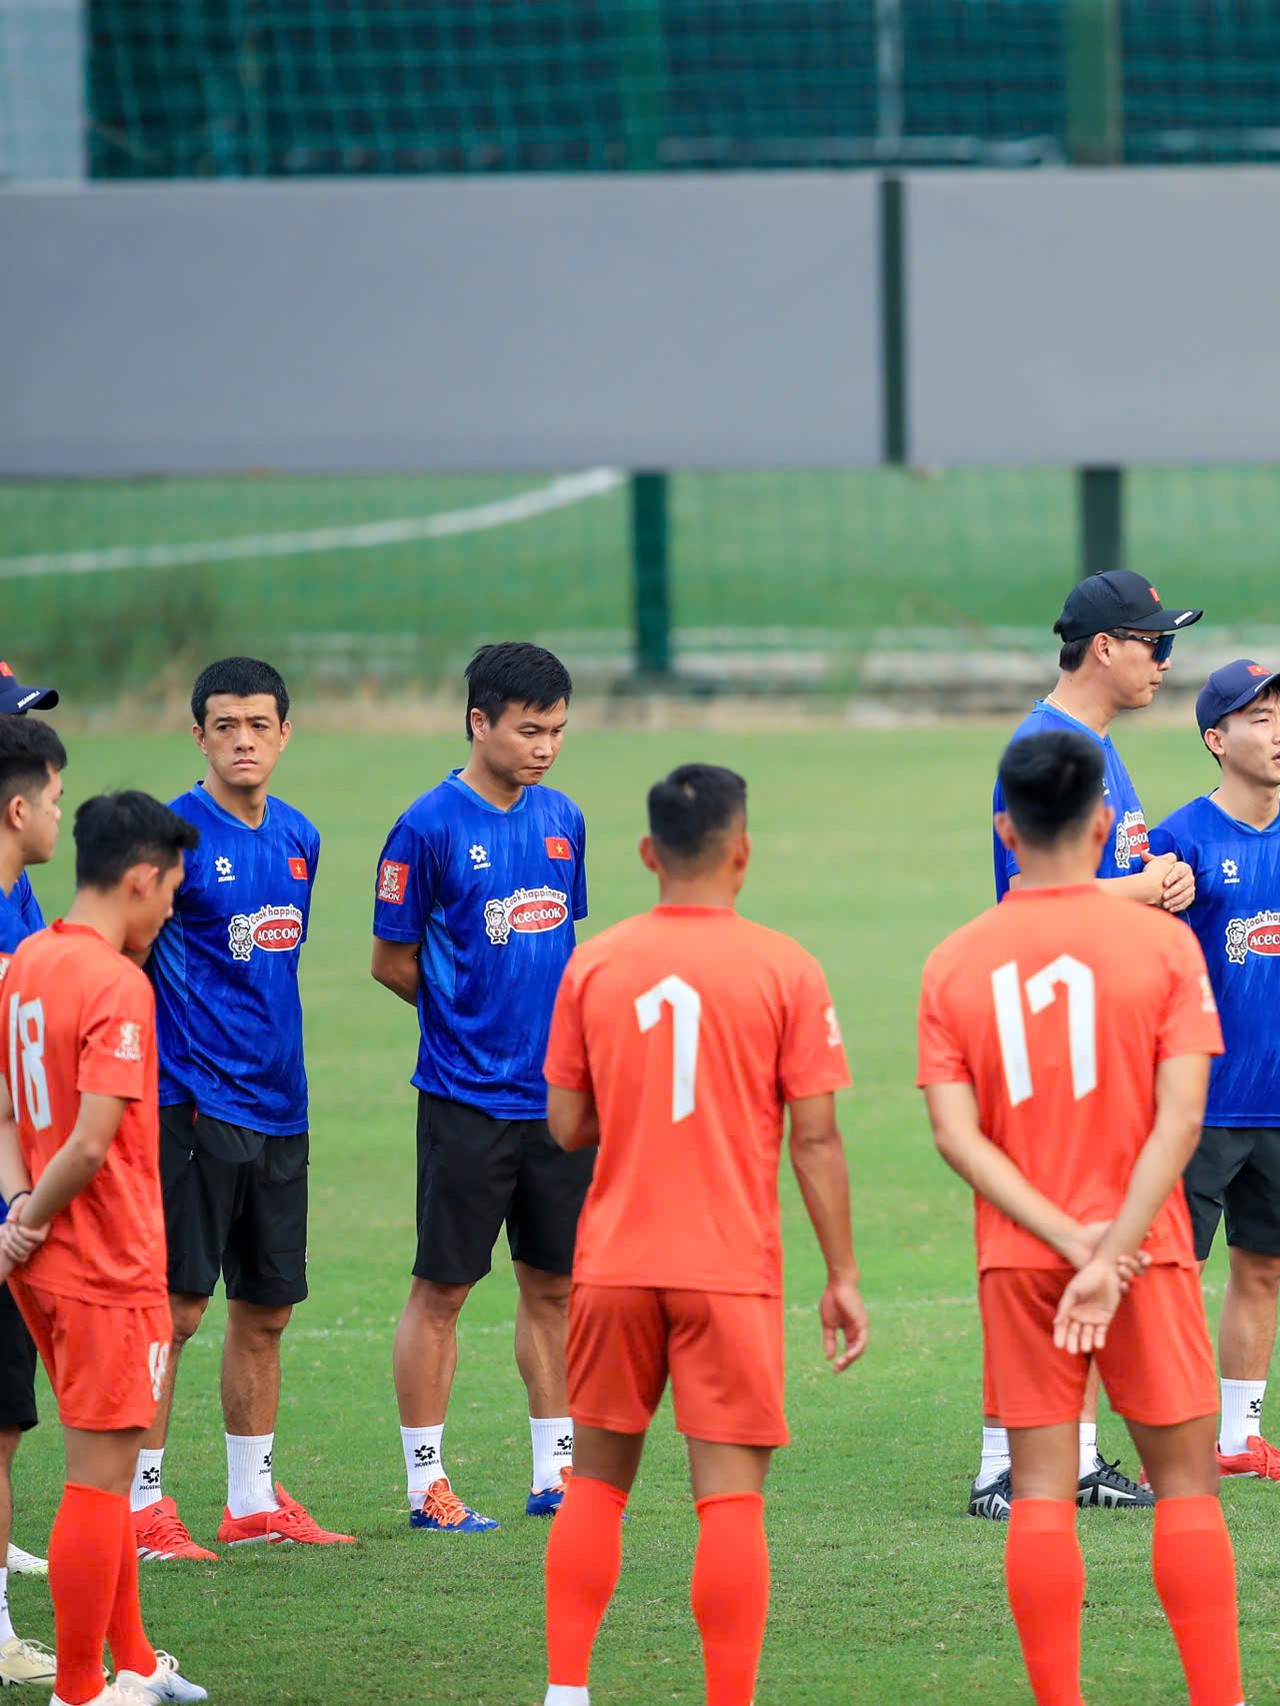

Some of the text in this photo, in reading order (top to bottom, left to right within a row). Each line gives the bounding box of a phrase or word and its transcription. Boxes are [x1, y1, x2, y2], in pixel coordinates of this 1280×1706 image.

[8, 991, 53, 1132] 18
[634, 973, 702, 1122] 7
[990, 953, 1097, 1107] 17
